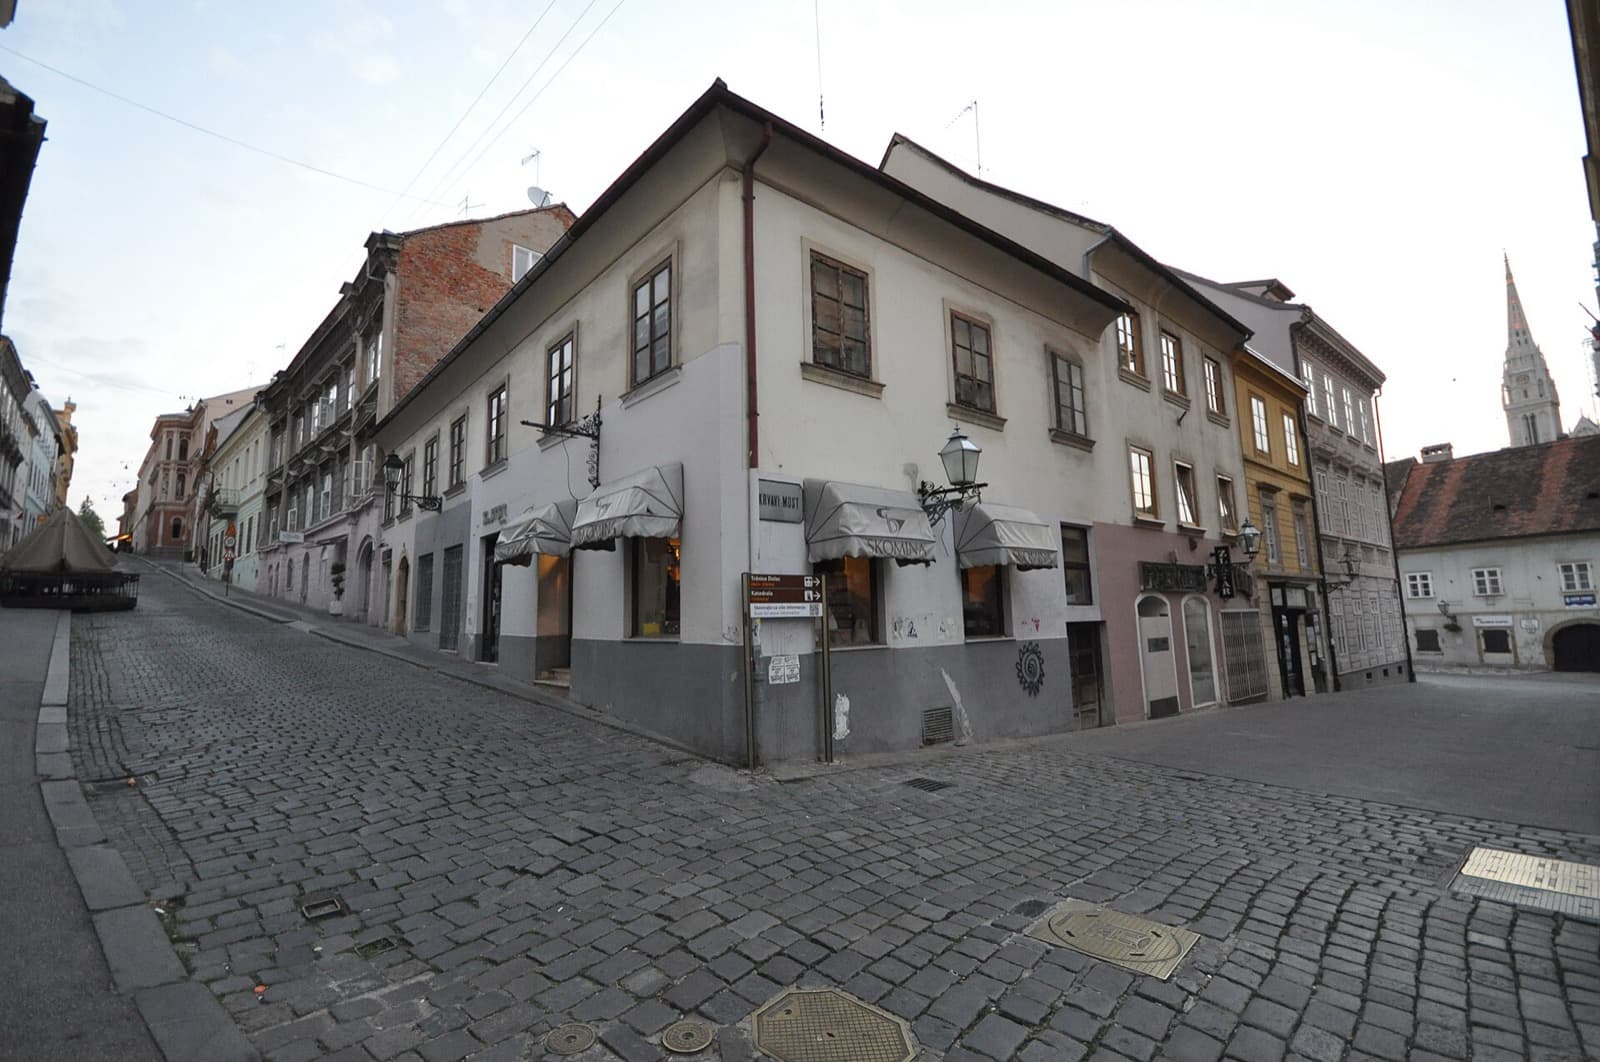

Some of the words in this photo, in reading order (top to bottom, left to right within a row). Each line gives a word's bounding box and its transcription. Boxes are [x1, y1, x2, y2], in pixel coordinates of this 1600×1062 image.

[758, 493, 780, 508] KRVAVI
[782, 495, 799, 509] MOST
[867, 538, 928, 557] SKOMINA
